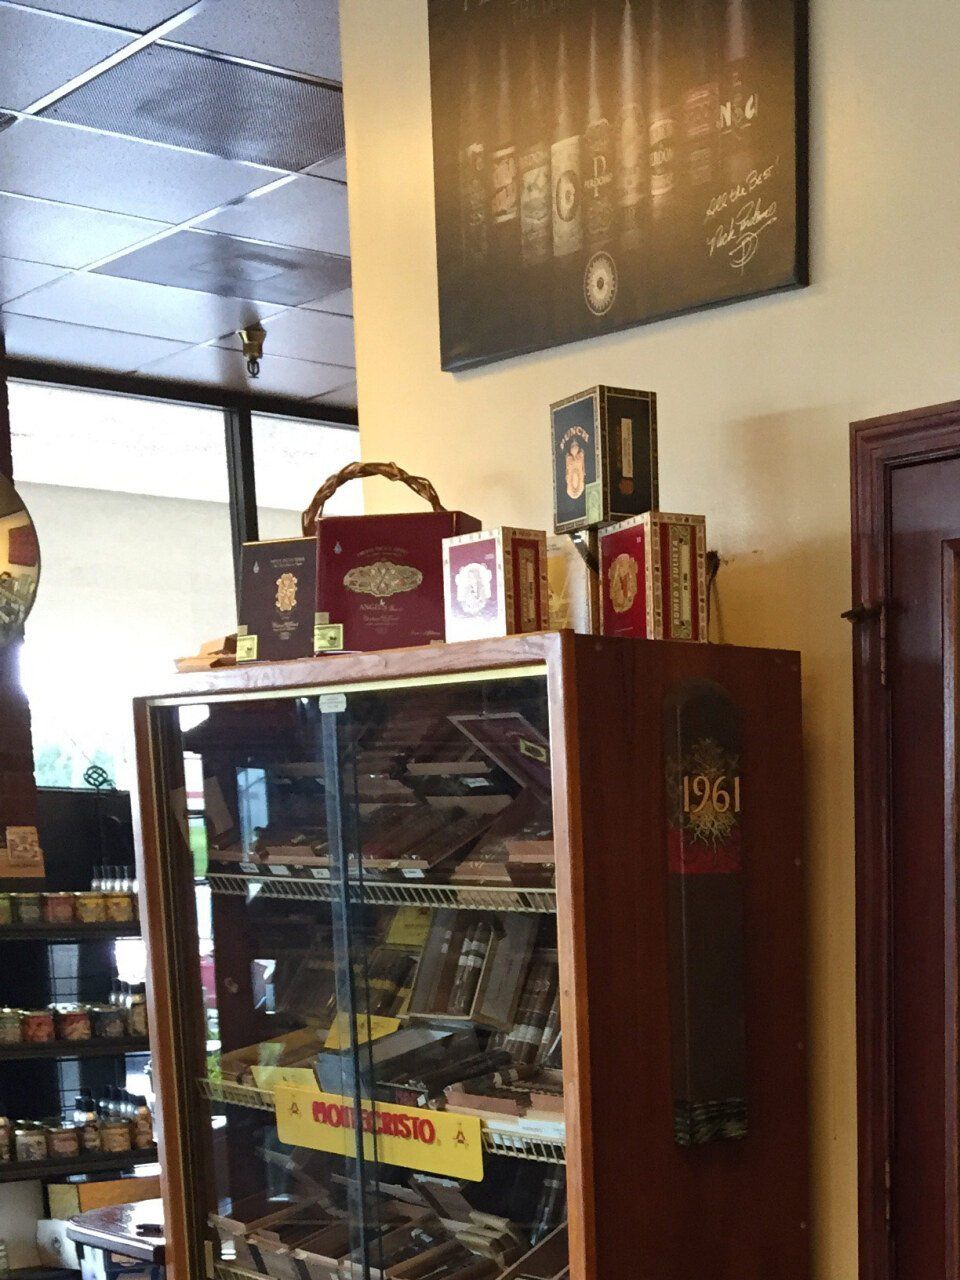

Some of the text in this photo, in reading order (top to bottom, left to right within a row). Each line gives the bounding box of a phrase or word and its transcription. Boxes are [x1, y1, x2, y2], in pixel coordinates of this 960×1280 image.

[559, 425, 590, 451] PUNCH
[673, 591, 681, 625] ROMEO
[683, 775, 741, 813] 1961
